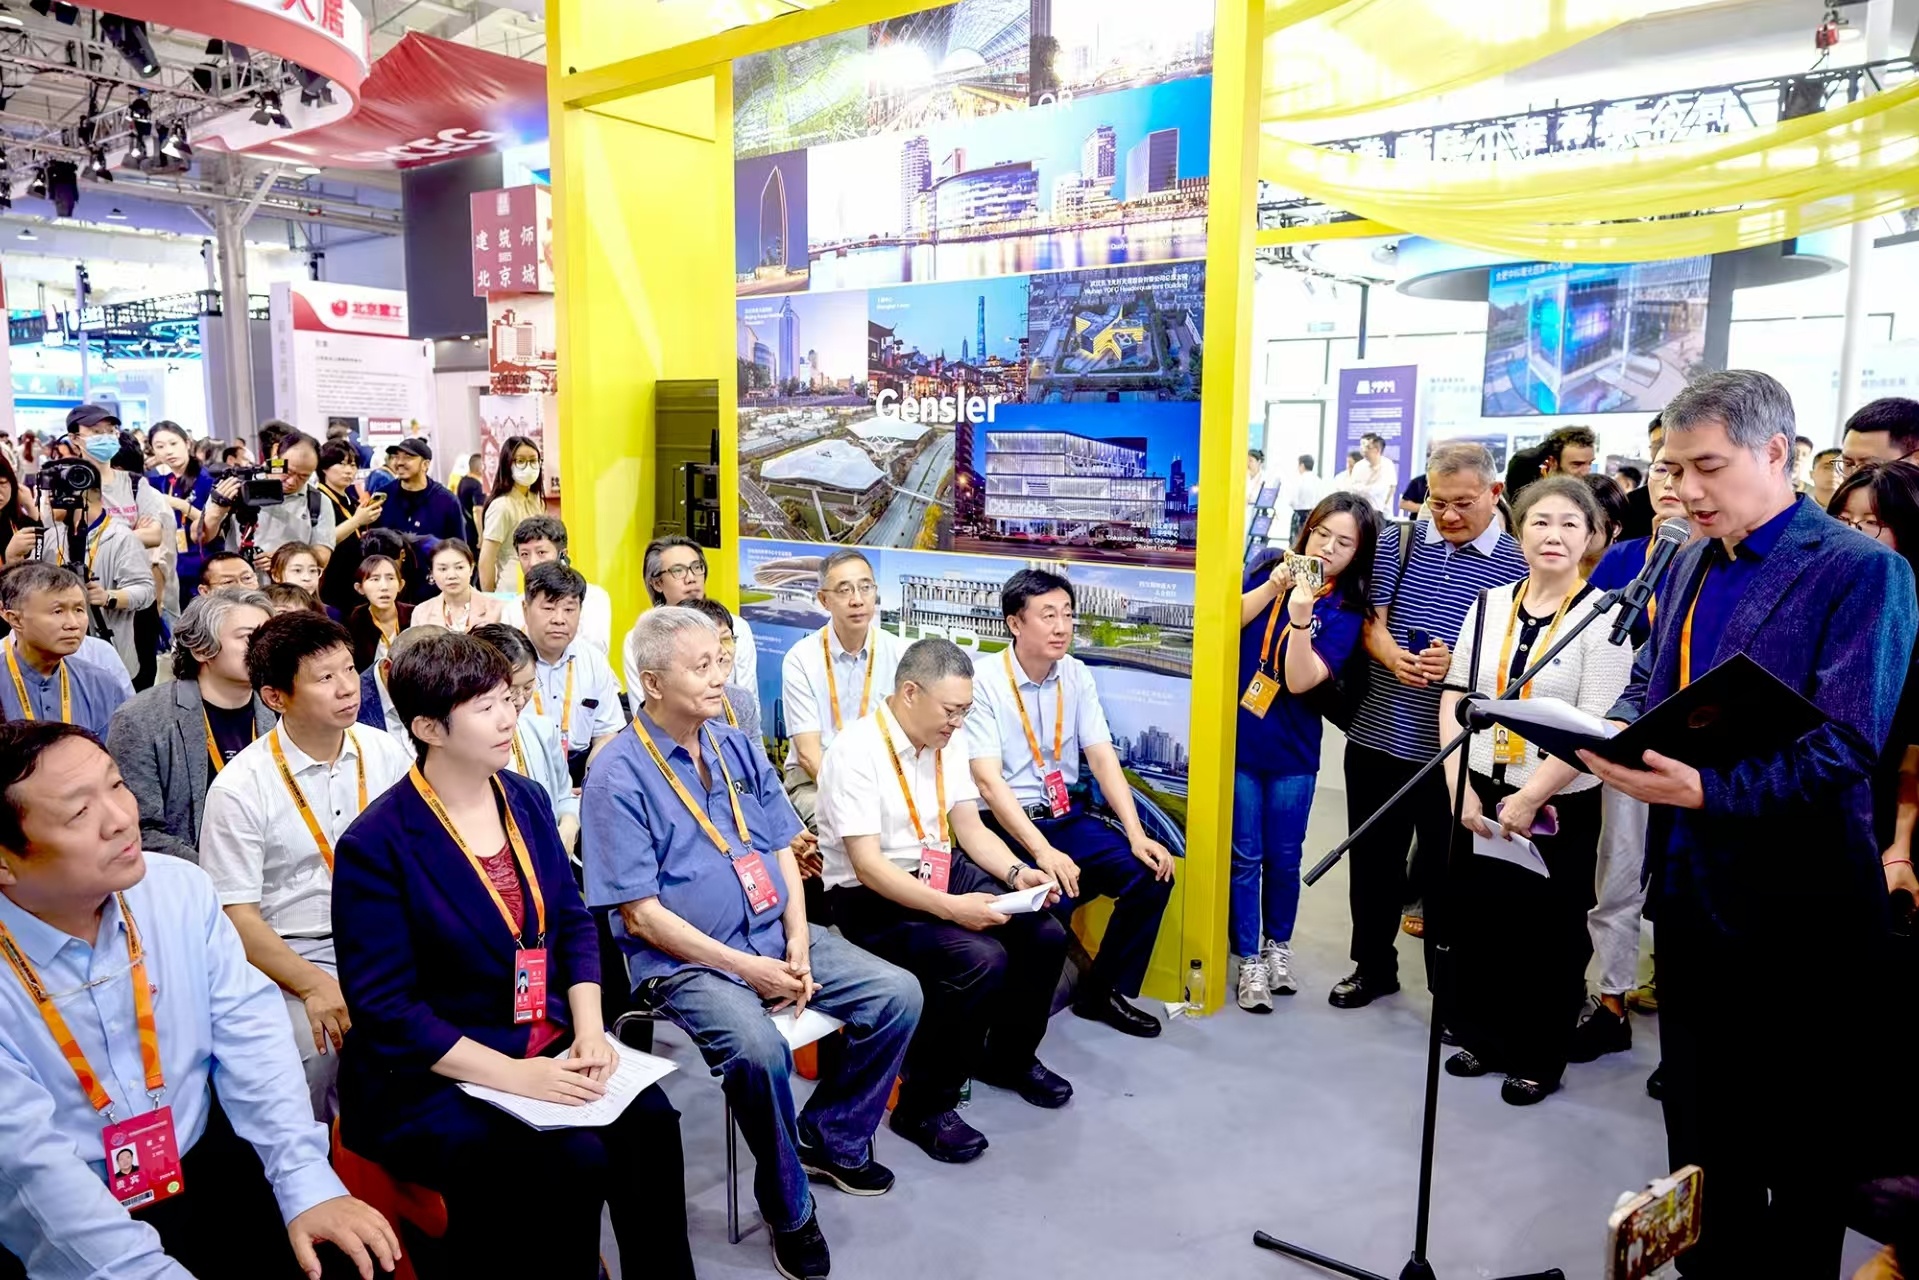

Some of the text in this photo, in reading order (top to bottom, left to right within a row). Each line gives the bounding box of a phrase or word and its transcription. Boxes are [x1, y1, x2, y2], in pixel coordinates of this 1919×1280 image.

[475, 226, 535, 251] 建筑师
[477, 264, 537, 288] 北京城
[875, 386, 1001, 423] Gensler
[1132, 536, 1153, 544] College
[1154, 537, 1178, 546] Chicago
